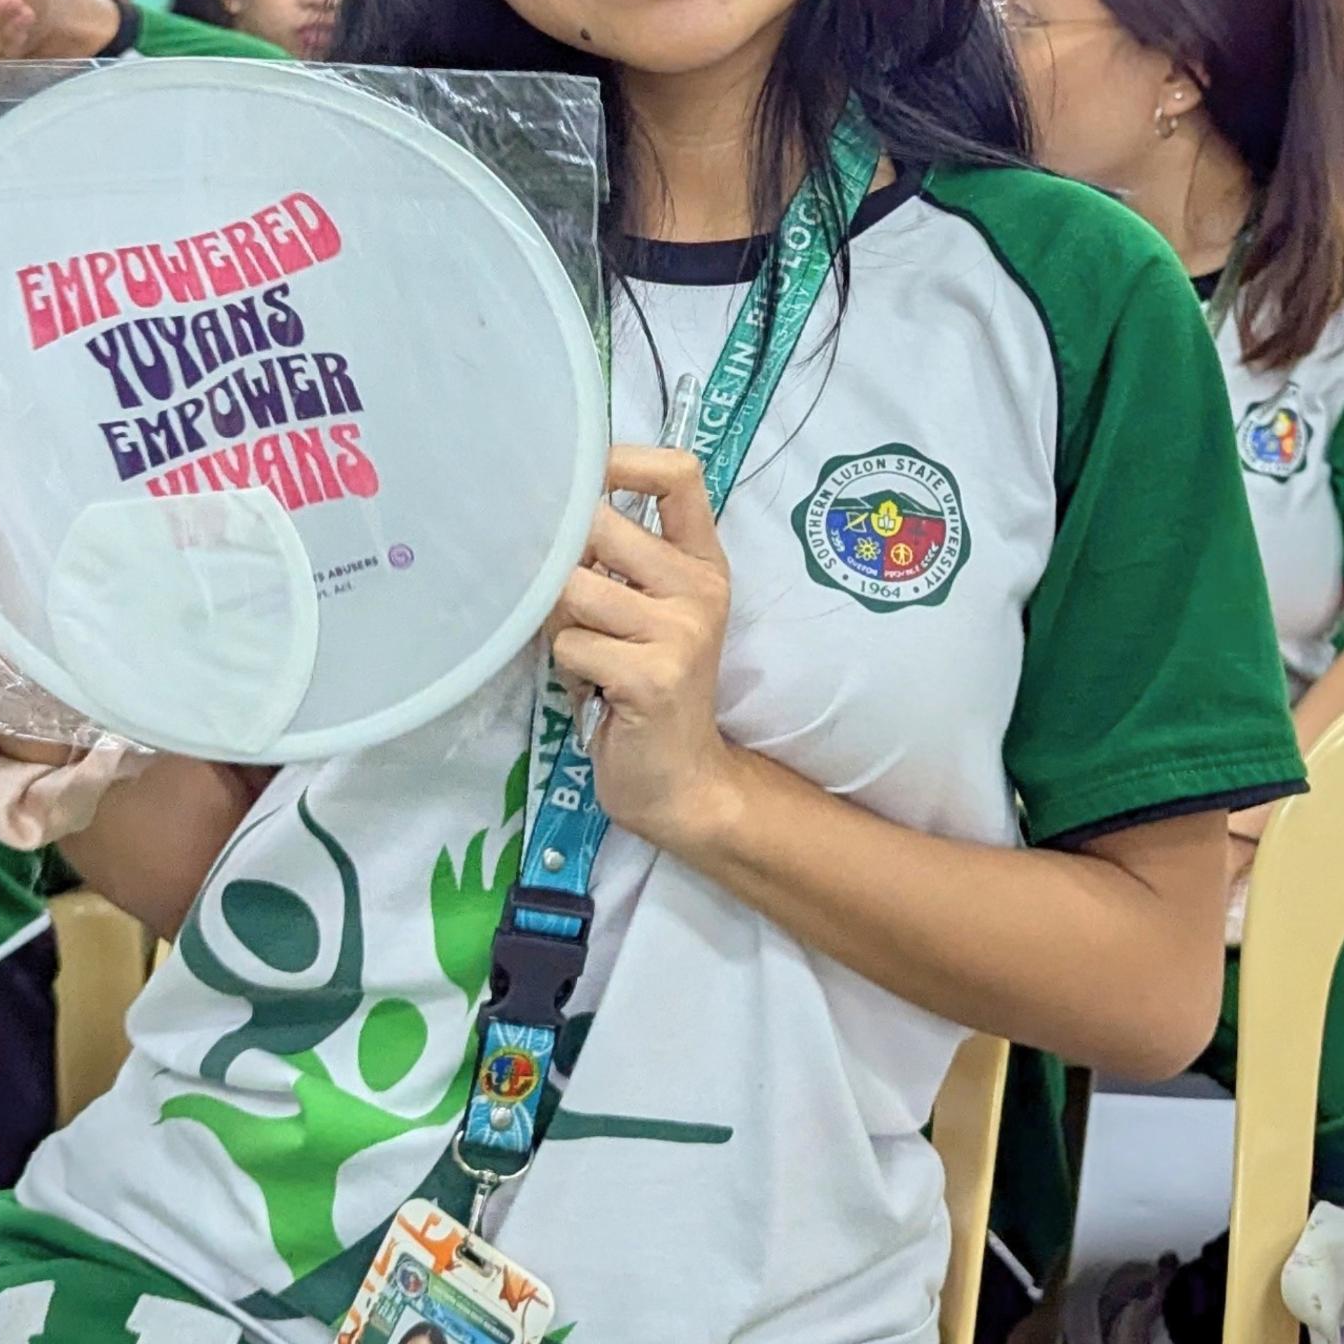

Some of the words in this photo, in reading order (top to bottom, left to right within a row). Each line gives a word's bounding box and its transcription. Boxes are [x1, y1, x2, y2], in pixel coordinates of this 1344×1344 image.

[16, 192, 342, 351] EMPOWERED
[85, 282, 305, 409] YUYANS
[98, 352, 364, 482] EMPOWER
[328, 555, 379, 580] ABUSERS
[808, 489, 837, 570] SOUTHERN
[831, 457, 886, 487] LUZON
[894, 458, 947, 491] STATE
[925, 493, 961, 590] UNIVERSITY
[859, 580, 902, 598] 1964
